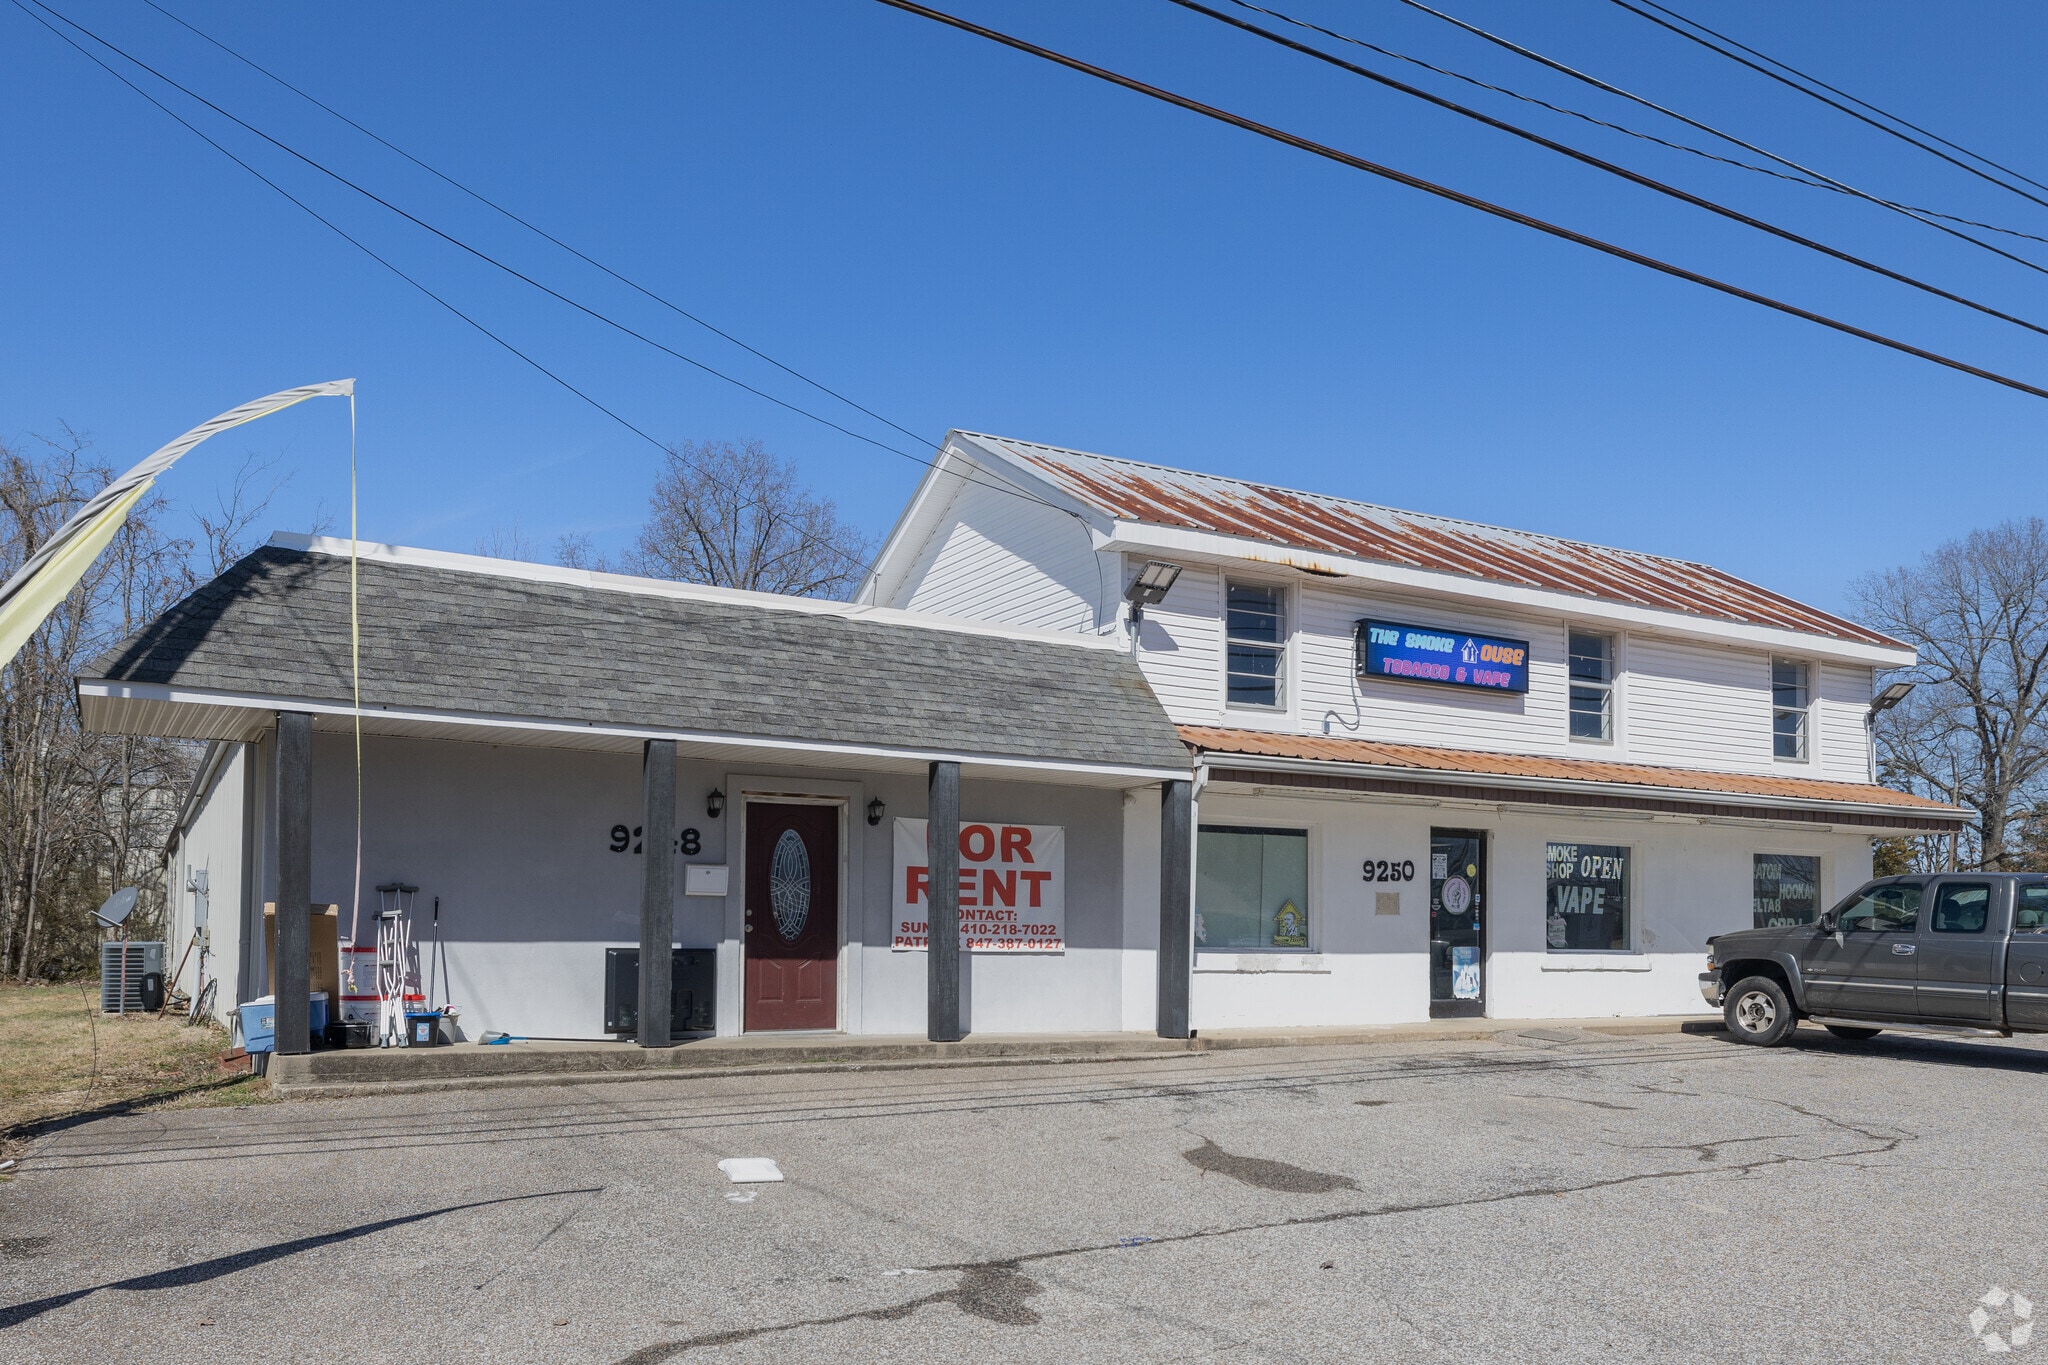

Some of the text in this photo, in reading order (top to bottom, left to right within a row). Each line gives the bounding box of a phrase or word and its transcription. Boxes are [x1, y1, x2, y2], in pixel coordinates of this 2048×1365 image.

[1370, 627, 1399, 646] THE
[1405, 633, 1455, 653] SMOKE
[1382, 658, 1511, 687] TOBACCO & VAPE
[609, 824, 702, 856] 98
[926, 822, 1035, 864] OR
[1546, 845, 1578, 862] MOKE
[1362, 860, 1415, 882] 9250
[1546, 862, 1574, 879] SHOP
[1580, 855, 1624, 880] OPEN
[906, 866, 1052, 907] RENT
[1779, 883, 1815, 900] HOOKAH
[1557, 885, 1606, 914] VAPE
[958, 909, 1018, 921] ONTACT:
[960, 923, 1057, 935] 410-218-7022
[966, 938, 1062, 949] 847-387-0127
